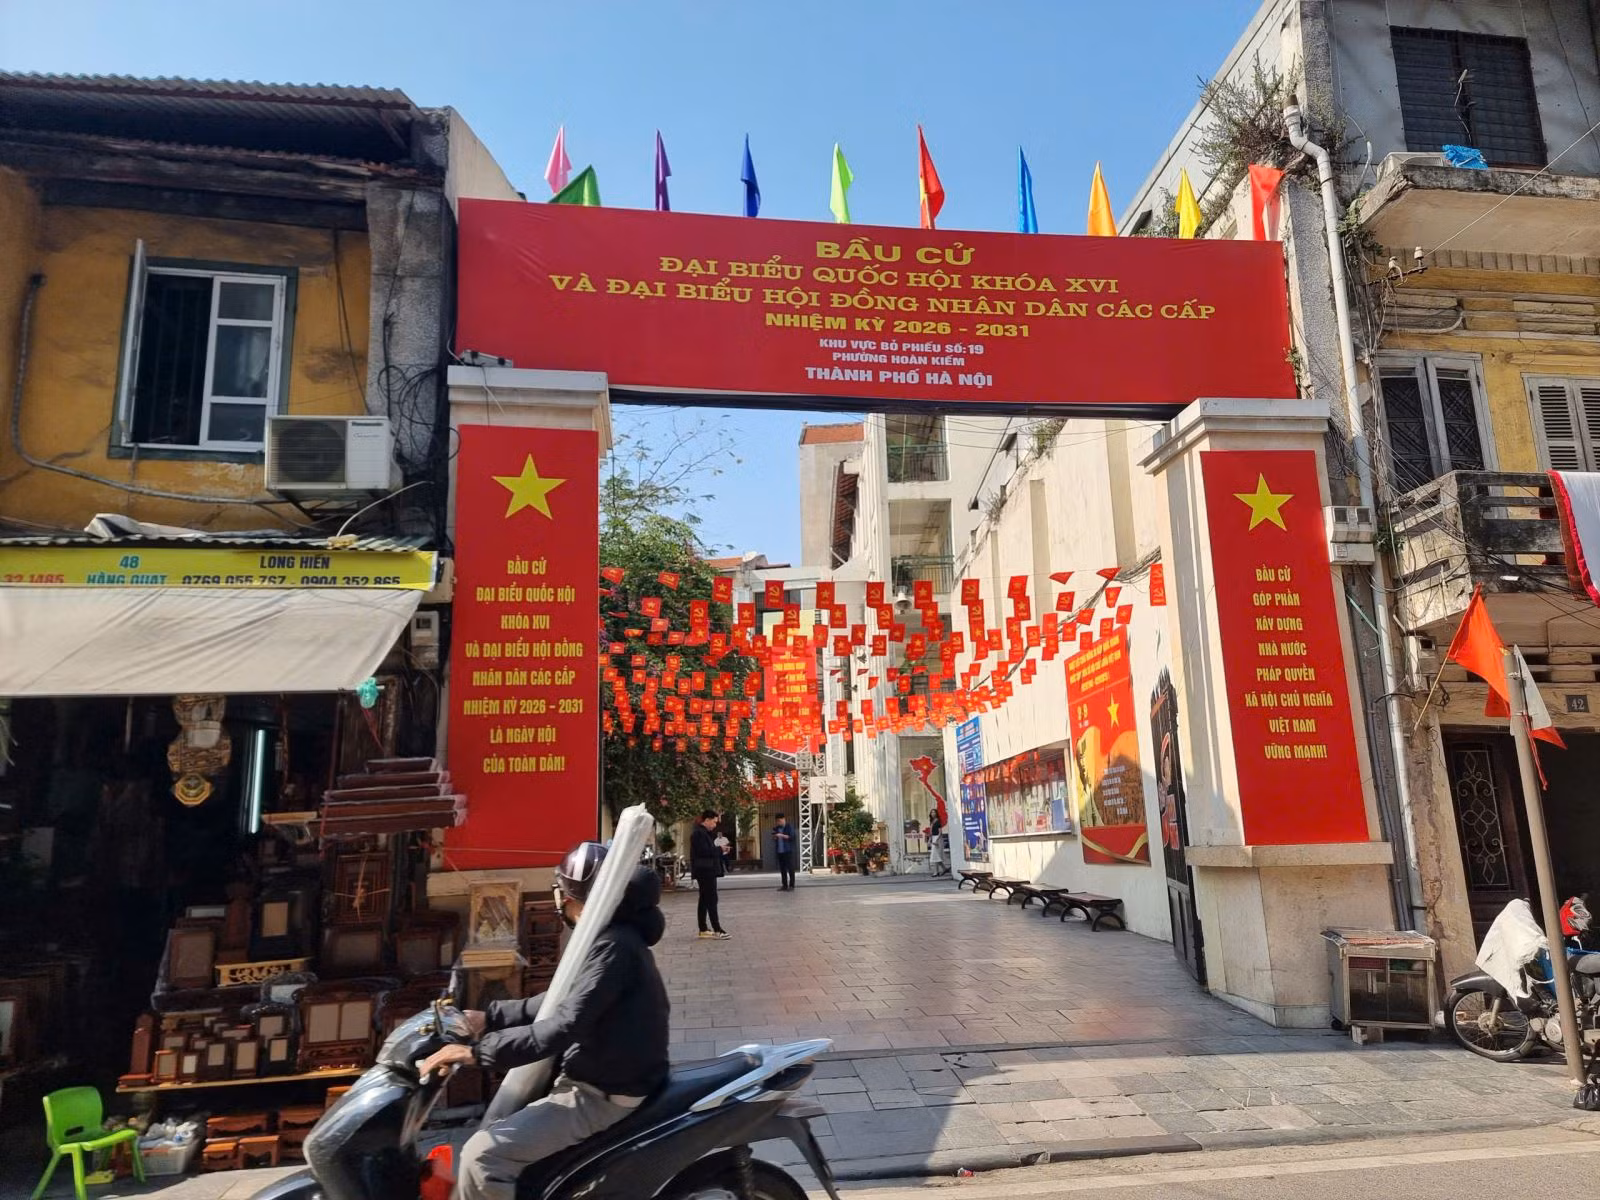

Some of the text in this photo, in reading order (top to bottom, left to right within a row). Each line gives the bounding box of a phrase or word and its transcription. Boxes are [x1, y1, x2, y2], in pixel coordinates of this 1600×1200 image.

[816, 237, 976, 265] BẦU CỬ
[659, 255, 1119, 293] ĐẠI BIỂU QUỐC HỘI KHÓA XVI
[548, 273, 1216, 319] VÀ ĐẠI BIỂU HỘI ĐỒNG NHÂN DÂN CÁC CẤP
[766, 312, 847, 331] NHIỆM
[855, 317, 885, 331] KỲ
[893, 320, 951, 335] 2026
[975, 323, 1029, 337] 2031
[820, 338, 847, 348] KHU
[850, 339, 876, 350] VỰC
[881, 339, 898, 351] BỎ
[902, 341, 940, 352] PHIẾU
[832, 352, 965, 366] PHƯỜNG HOÀN KIẾM
[805, 366, 993, 388] THÀNH PHỐ HÀ NỘI
[120, 556, 139, 569] 48
[259, 555, 296, 569] LONG
[507, 555, 547, 575] BẦU CỬ
[1255, 563, 1291, 582] BẦU CỬ
[476, 581, 576, 605] ĐẠI BIỂU QUỐC HỘI
[1252, 588, 1300, 606] GÓP PHẦN
[500, 612, 550, 630] KHÓA XVI
[1255, 615, 1304, 634] XÂY DỰNG
[465, 640, 480, 658] VÀ
[482, 642, 502, 660] ĐẠI
[504, 636, 529, 657] BIỂU
[532, 639, 551, 660] HỘI
[1258, 640, 1307, 656] NHÀ NƯỚC
[472, 665, 576, 686] NHÂN DÂN CÁC CẤP
[1256, 663, 1316, 682] PHÁP QUYỀN
[463, 697, 500, 718] NHIỆM
[503, 696, 517, 714] KỲ
[519, 699, 546, 714] 2026
[558, 699, 584, 714] 2031
[1244, 689, 1334, 709] XÃ HỘI CHỦ NGHĨA
[1571, 698, 1585, 710] 42
[489, 725, 556, 746] LÀ NGÀY HỘI
[1269, 716, 1316, 736] VIỆT NAM
[1264, 742, 1328, 762] VỮNG MẠNH!
[483, 753, 565, 774] CỦA TOÀN DÂN!
